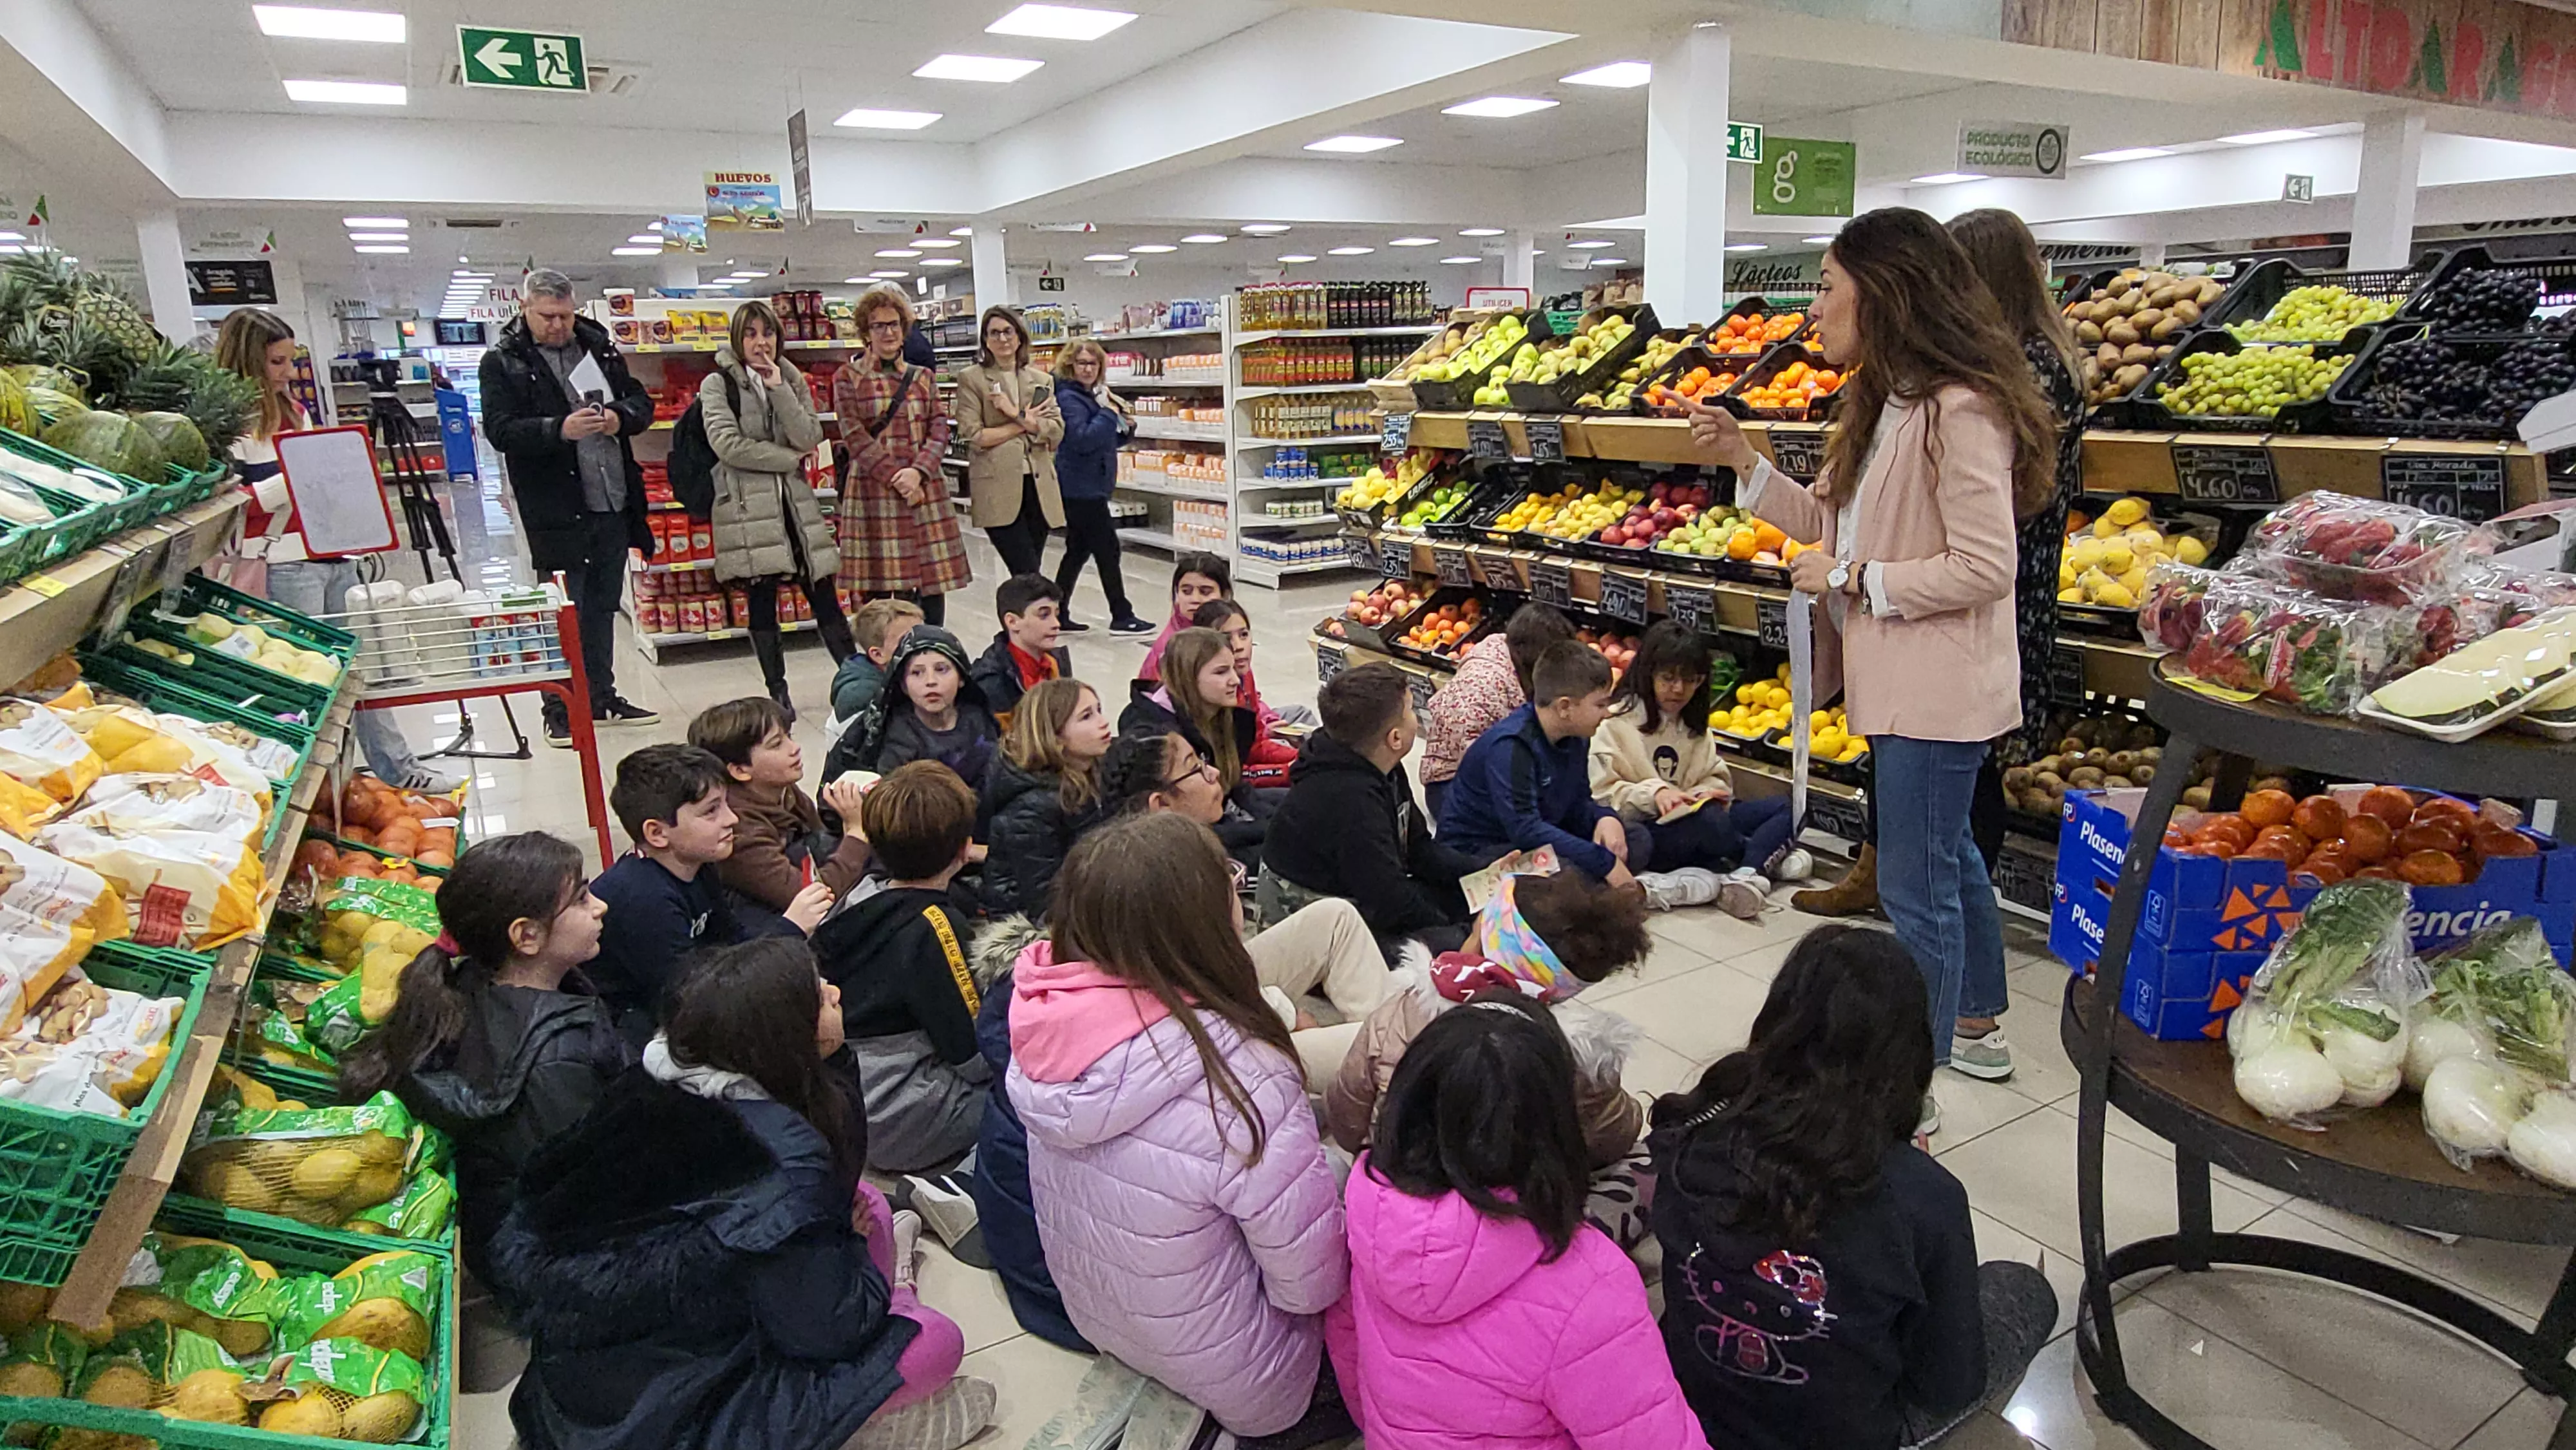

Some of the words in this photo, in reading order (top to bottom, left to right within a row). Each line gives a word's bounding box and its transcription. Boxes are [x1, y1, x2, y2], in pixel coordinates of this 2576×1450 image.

[1967, 131, 2031, 147] PRODUCTO
[1965, 149, 2032, 165] ECOLÓGICO
[715, 173, 772, 183] HUEVOS
[489, 288, 520, 302] FILA
[471, 308, 494, 319] FILA
[2187, 476, 2237, 499] 4.60
